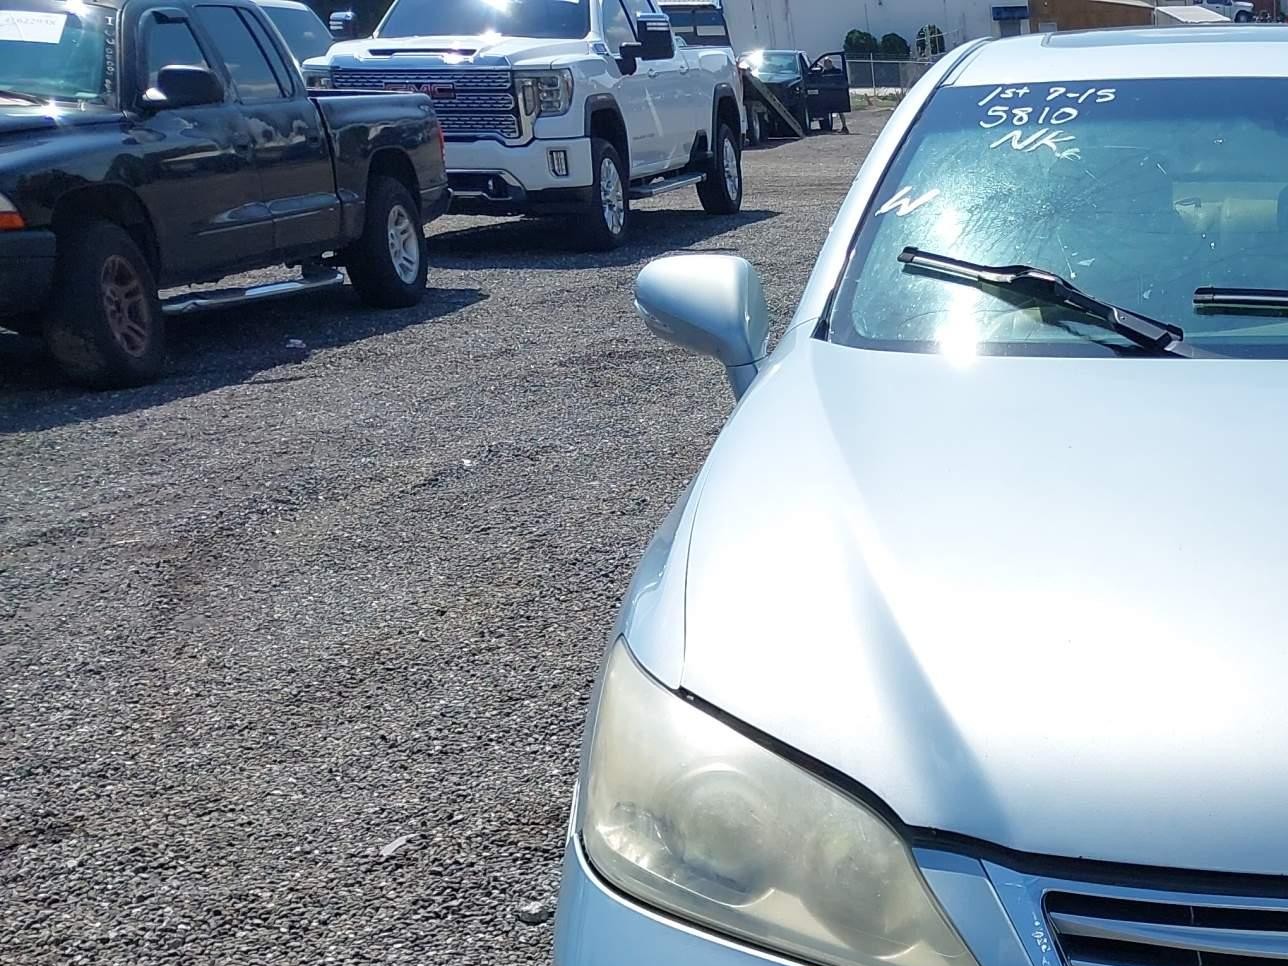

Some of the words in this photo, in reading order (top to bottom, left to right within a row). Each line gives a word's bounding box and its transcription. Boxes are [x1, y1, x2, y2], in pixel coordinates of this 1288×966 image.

[978, 86, 1030, 106] 1st
[1046, 87, 1117, 104] 7-15
[979, 106, 1078, 128] 5810
